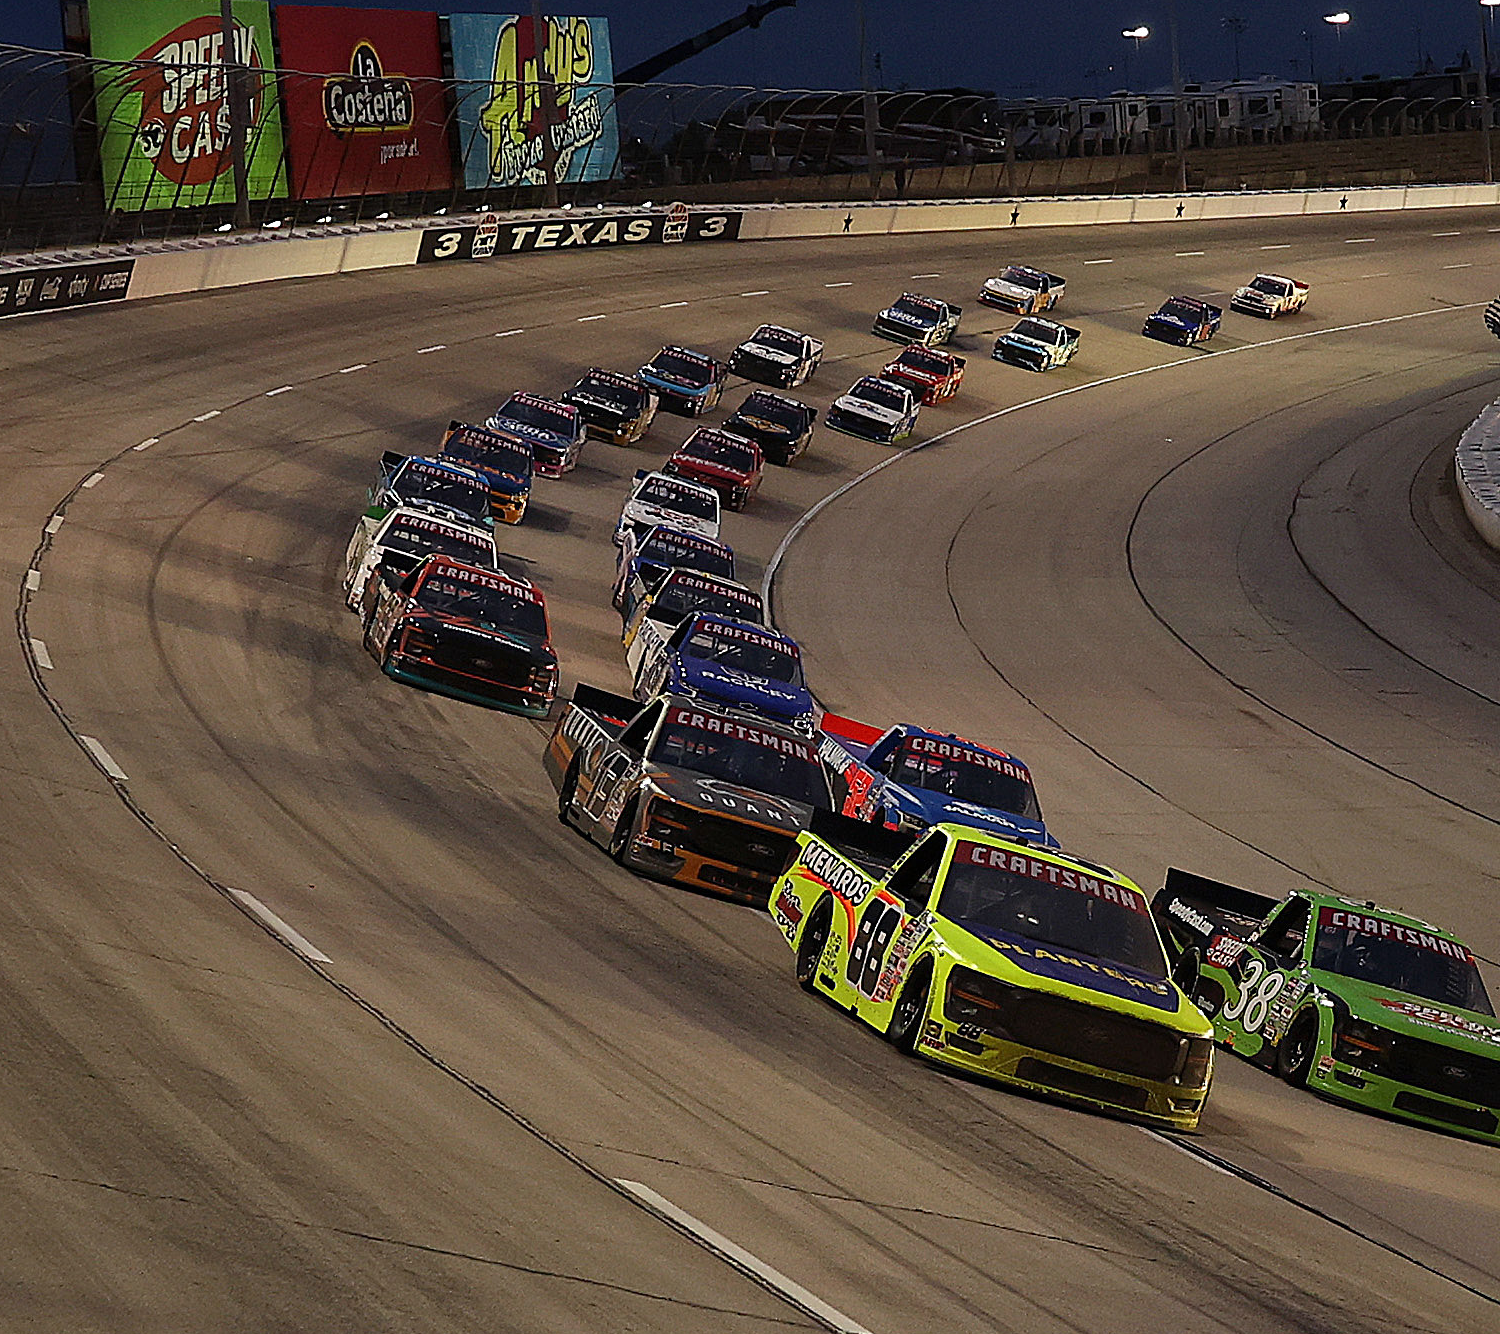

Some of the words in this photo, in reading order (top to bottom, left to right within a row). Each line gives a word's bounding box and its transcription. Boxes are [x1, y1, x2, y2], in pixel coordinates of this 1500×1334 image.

[154, 25, 256, 114] SPEEY
[357, 53, 375, 79] La
[171, 96, 255, 164] CAS!
[434, 232, 462, 257] 3
[510, 219, 653, 250] TEXAS
[700, 216, 728, 238] 3
[400, 516, 487, 549] CRAFTSMAN
[658, 531, 729, 561] CRAFTSMAN
[436, 565, 535, 603] CRAFTSMAN
[677, 575, 758, 608] CRAFTSMAN
[703, 622, 793, 656] CRAFTSMAN
[677, 710, 808, 758] CRAFTSMAN
[911, 738, 1027, 781] CRAFTSMAN
[801, 842, 871, 906] MENARDS
[970, 846, 1137, 911] CRAFTSMAN
[846, 897, 902, 995] 88
[1331, 911, 1468, 962] CRAFTSMAN
[1211, 951, 1236, 968] CASH
[1222, 959, 1285, 1035] 38
